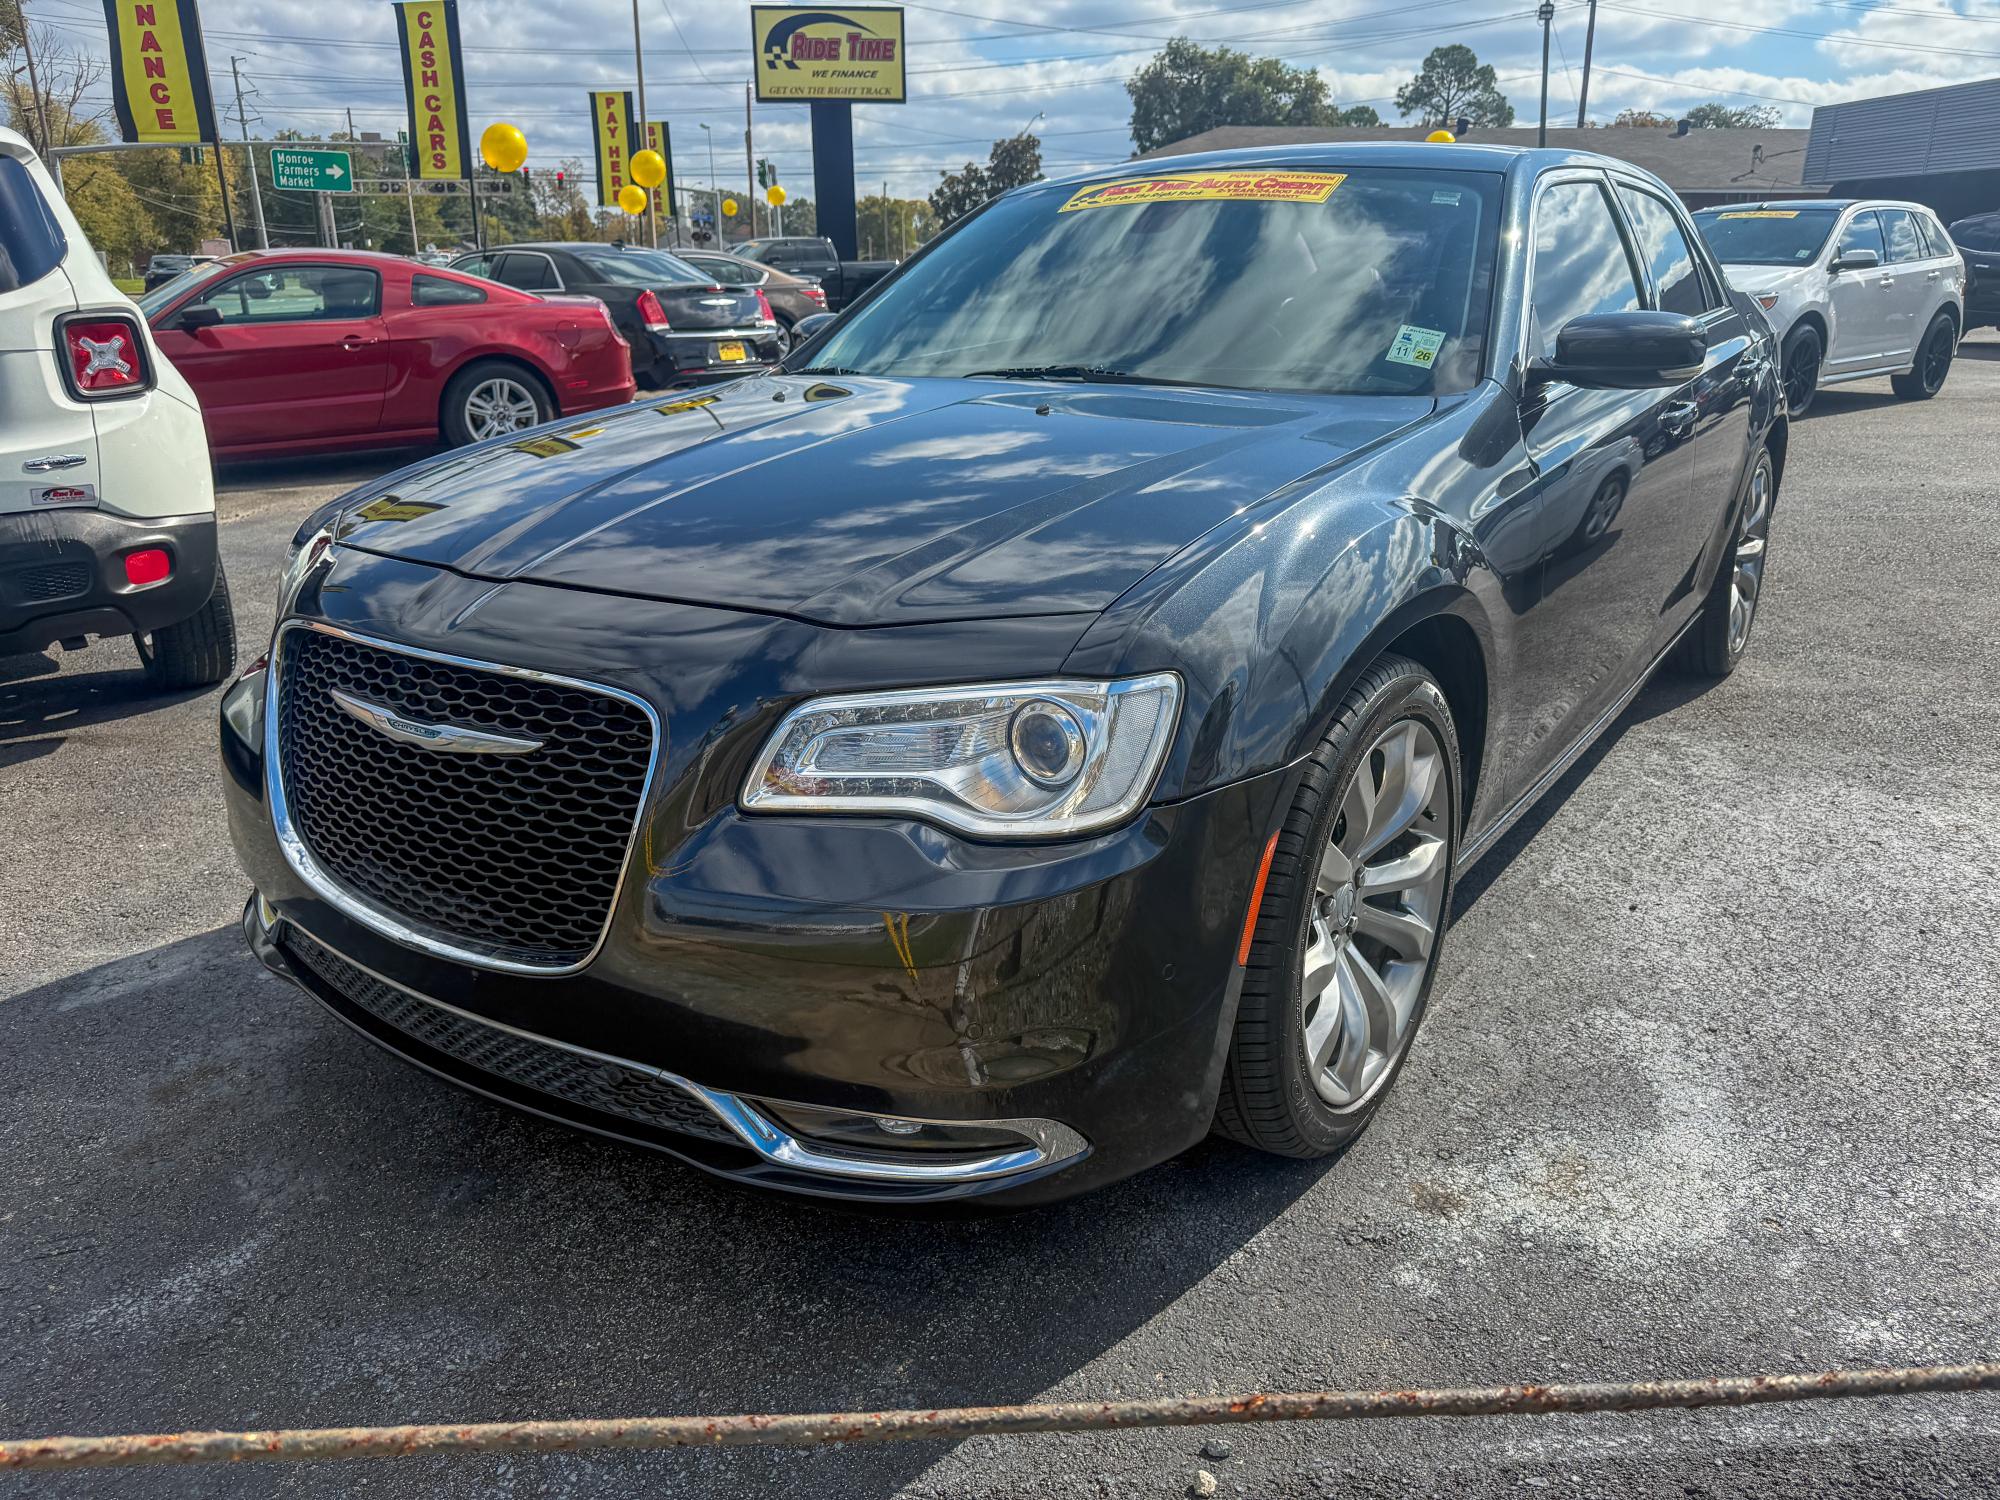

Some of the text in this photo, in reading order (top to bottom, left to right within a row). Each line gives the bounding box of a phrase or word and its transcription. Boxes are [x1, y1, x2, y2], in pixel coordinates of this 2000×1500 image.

[791, 32, 896, 61] RIDE TIME
[812, 70, 879, 78] WE FINANCE
[417, 11, 447, 170] CASH CARS
[769, 86, 892, 95] GET ON THE RIGHT TRACK
[605, 97, 619, 139] PAY
[277, 152, 314, 164] Monroe
[278, 164, 320, 176] Farmers
[280, 175, 314, 187] Market
[1396, 346, 1409, 356] 11
[1415, 350, 1431, 361] 26
[393, 721, 438, 738] CHRYSLER
